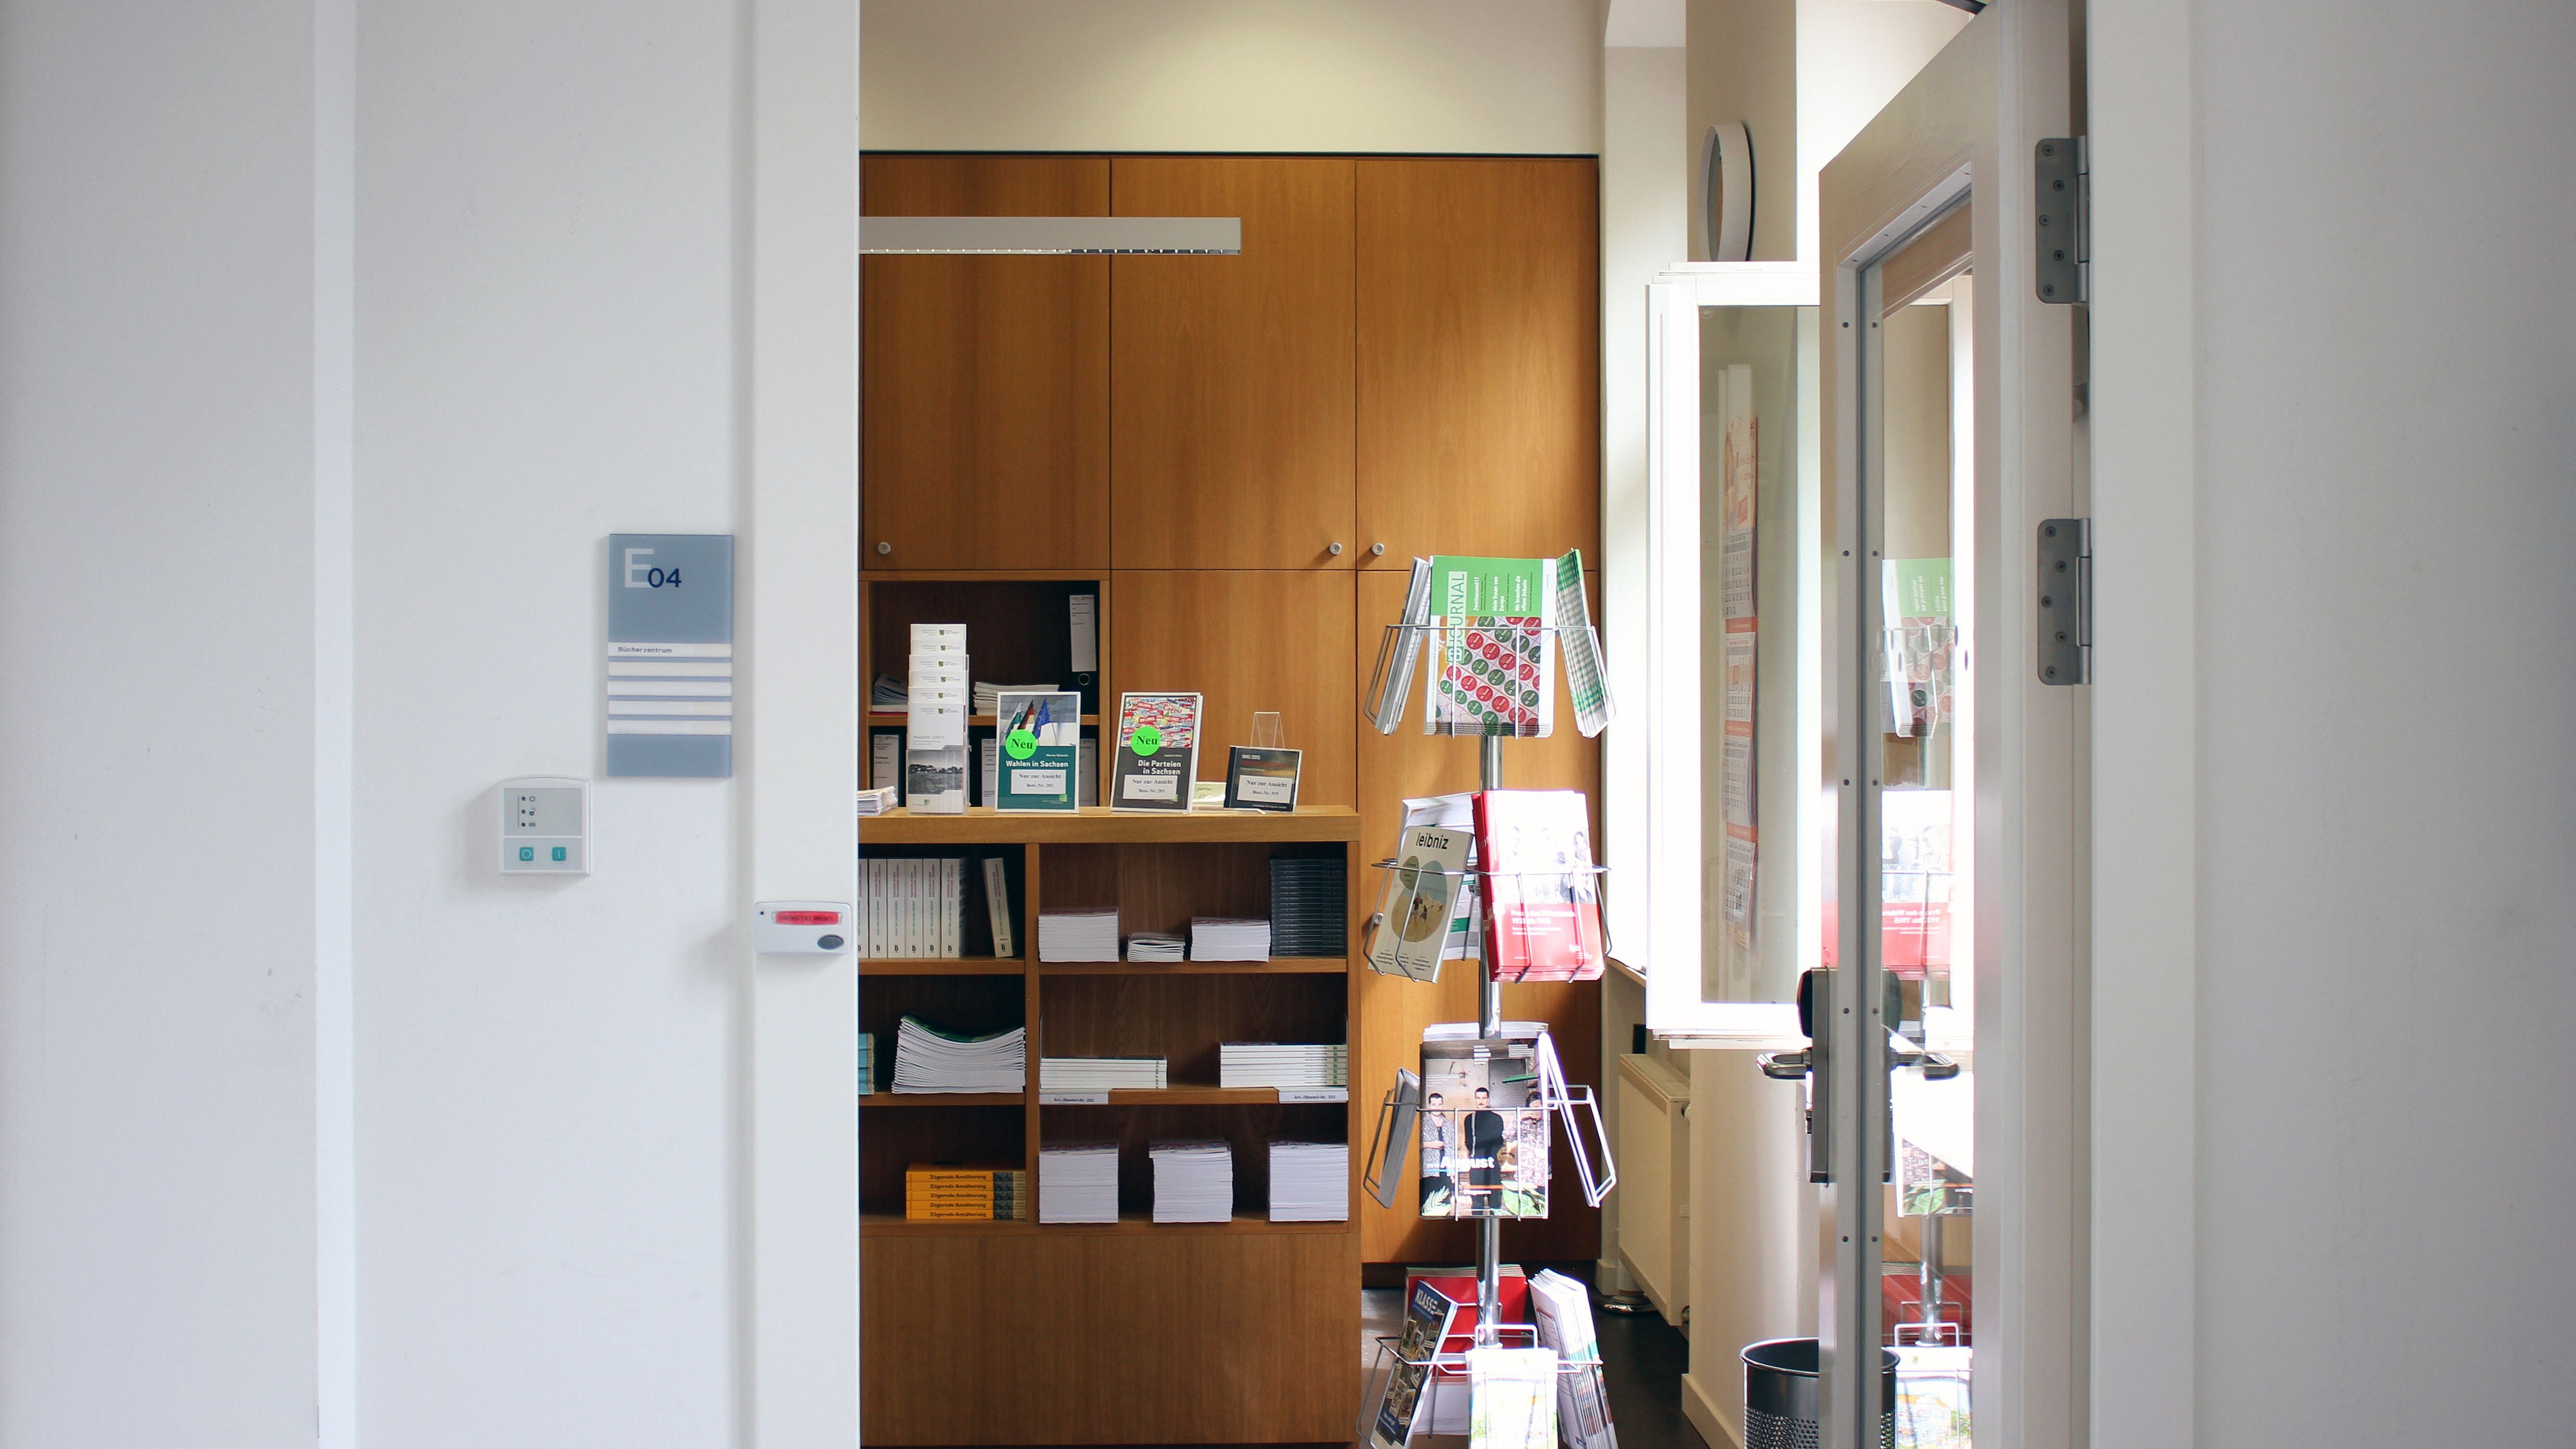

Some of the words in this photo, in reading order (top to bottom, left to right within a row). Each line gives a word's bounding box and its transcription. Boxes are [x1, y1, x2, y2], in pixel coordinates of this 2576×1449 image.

[1011, 739, 1033, 749] Neu
[1137, 735, 1158, 745] Neu
[1416, 832, 1449, 850] leibniz
